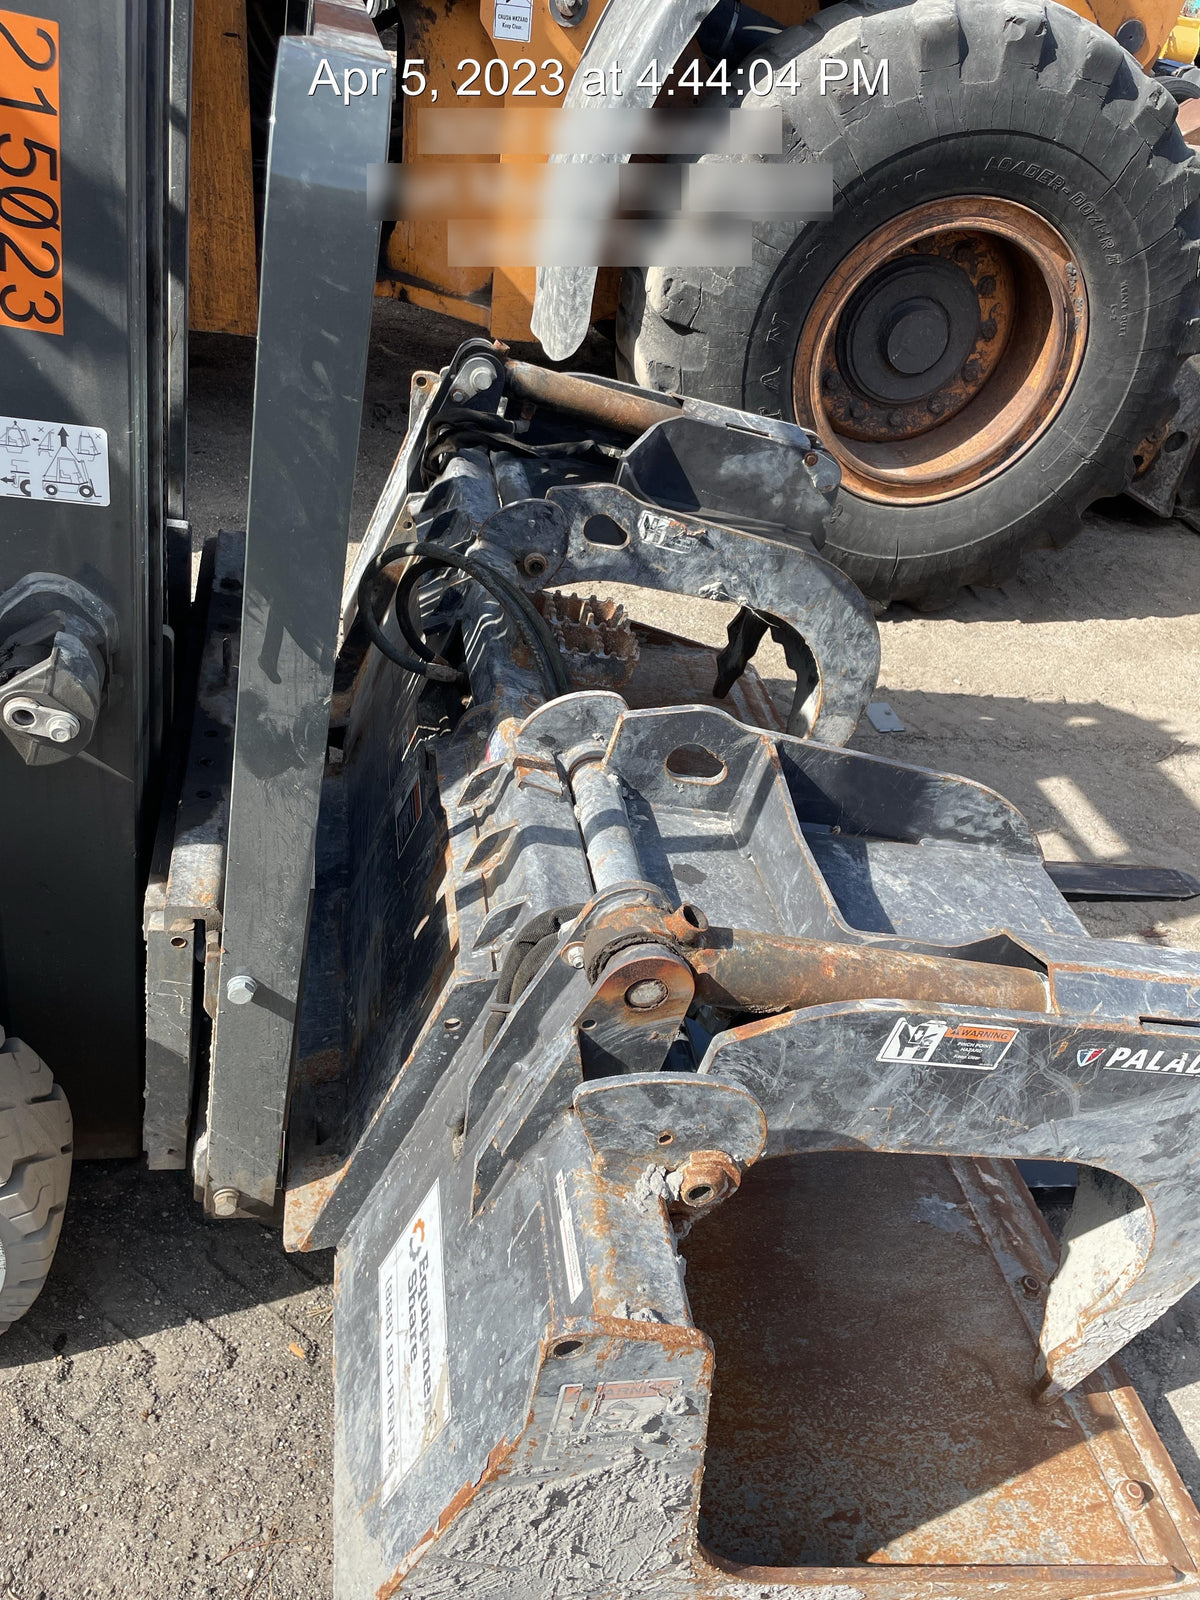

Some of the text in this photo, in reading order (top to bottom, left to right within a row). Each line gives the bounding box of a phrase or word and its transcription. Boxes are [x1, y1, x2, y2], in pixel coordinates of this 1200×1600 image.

[961, 1029, 1008, 1040] WARNING
[408, 1268, 417, 1364] Share
[418, 1250, 433, 1424] Equipmen
